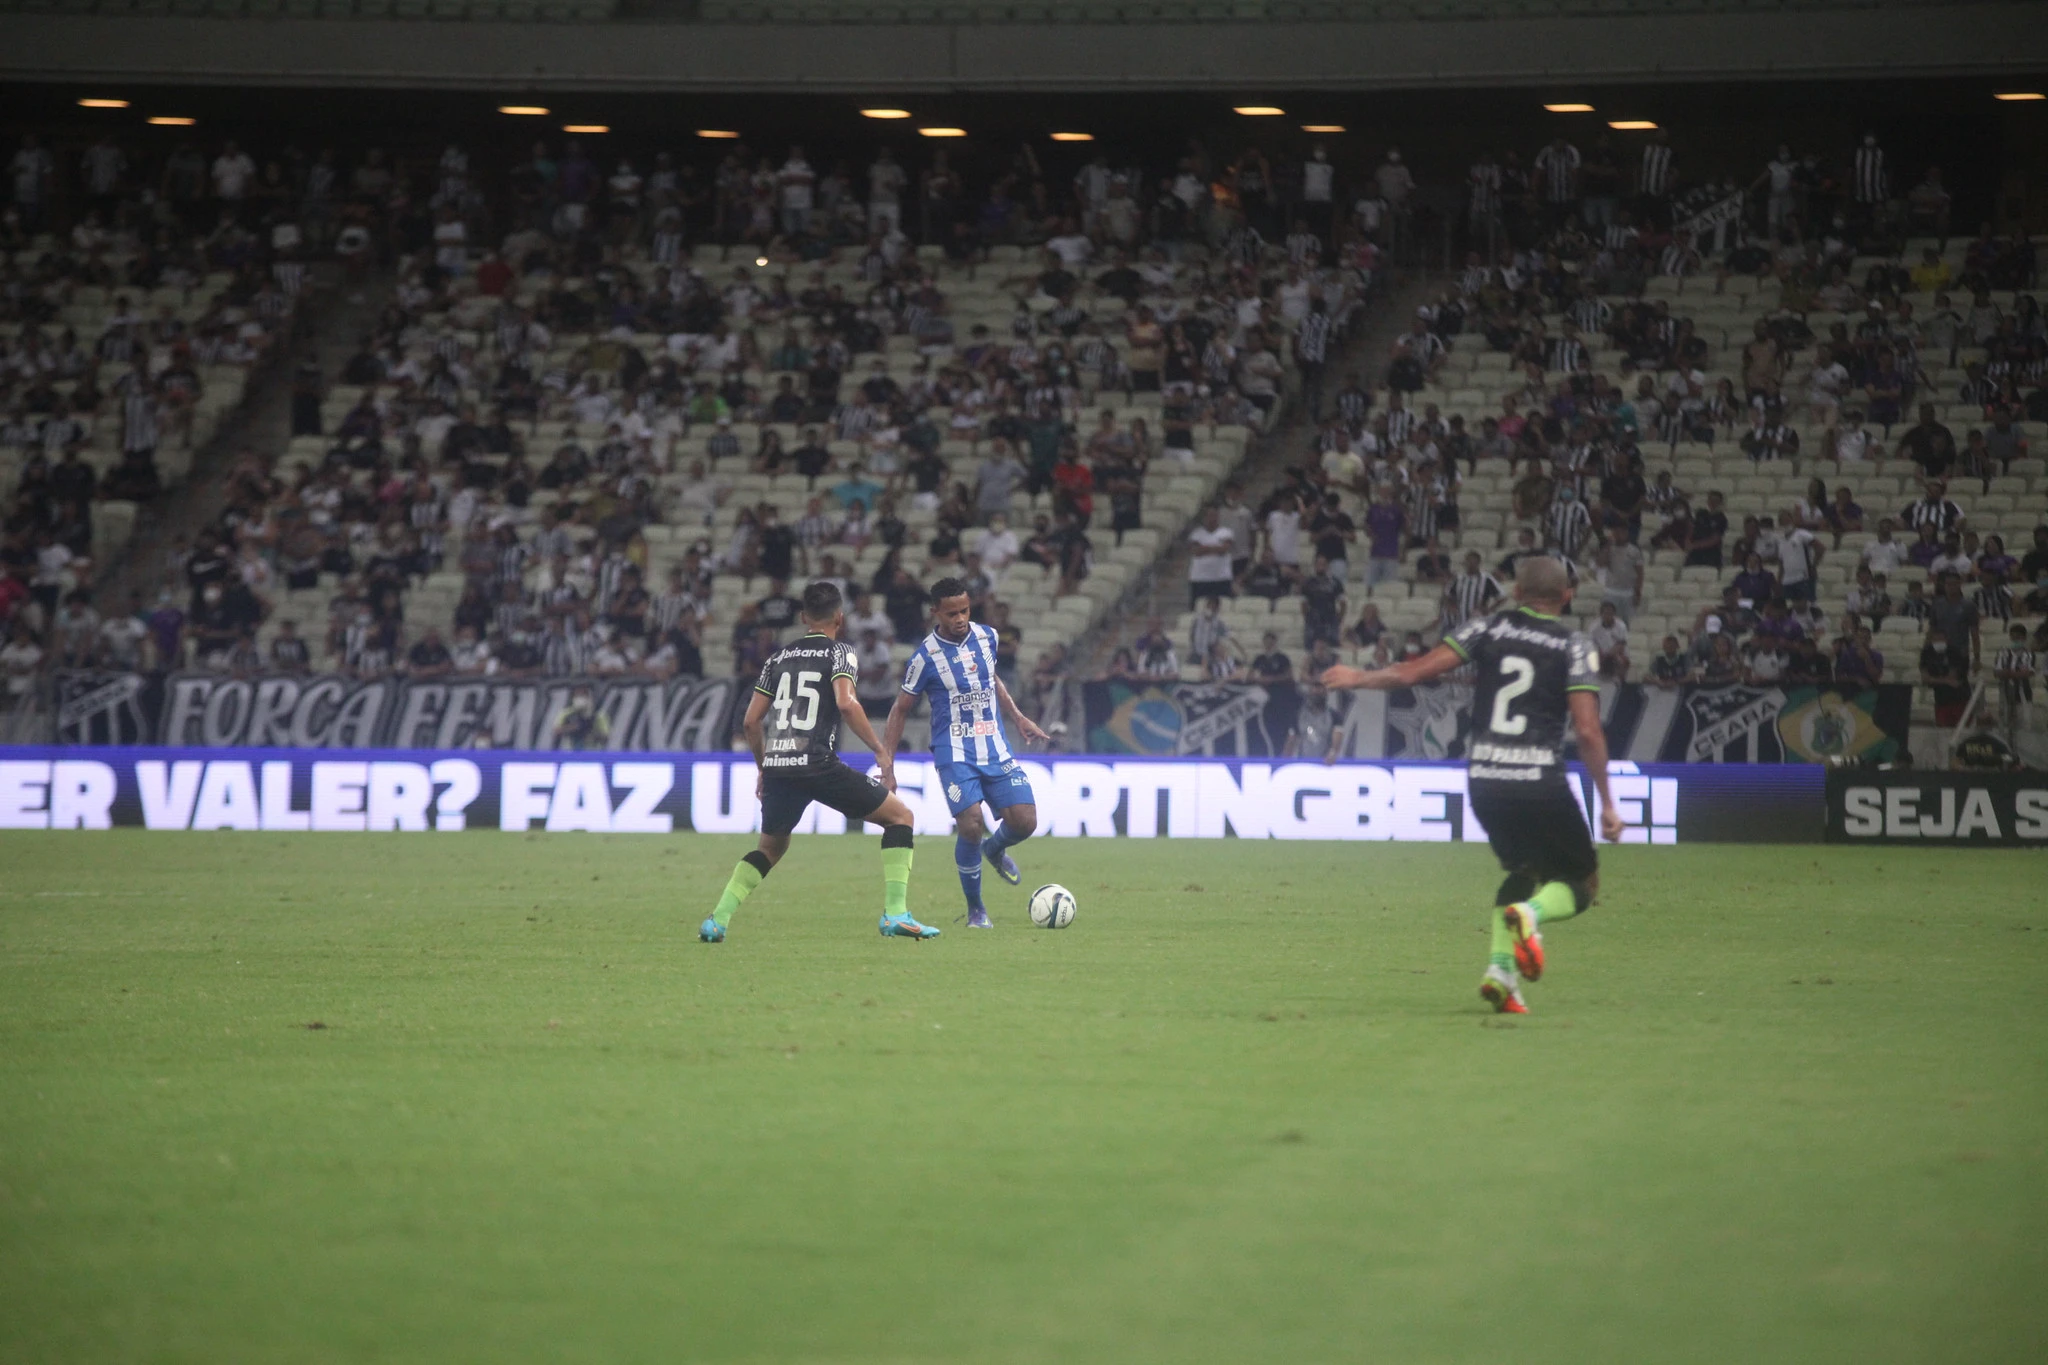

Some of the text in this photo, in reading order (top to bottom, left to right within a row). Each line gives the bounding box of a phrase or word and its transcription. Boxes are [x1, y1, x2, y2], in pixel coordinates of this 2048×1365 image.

[394, 683, 730, 749] FEMIINA
[773, 671, 822, 730] 45
[1490, 655, 1535, 735] 2
[0, 760, 117, 830] ER
[135, 758, 482, 832] VALER?
[500, 762, 674, 833] FAZ
[1844, 786, 2002, 838] SEJA
